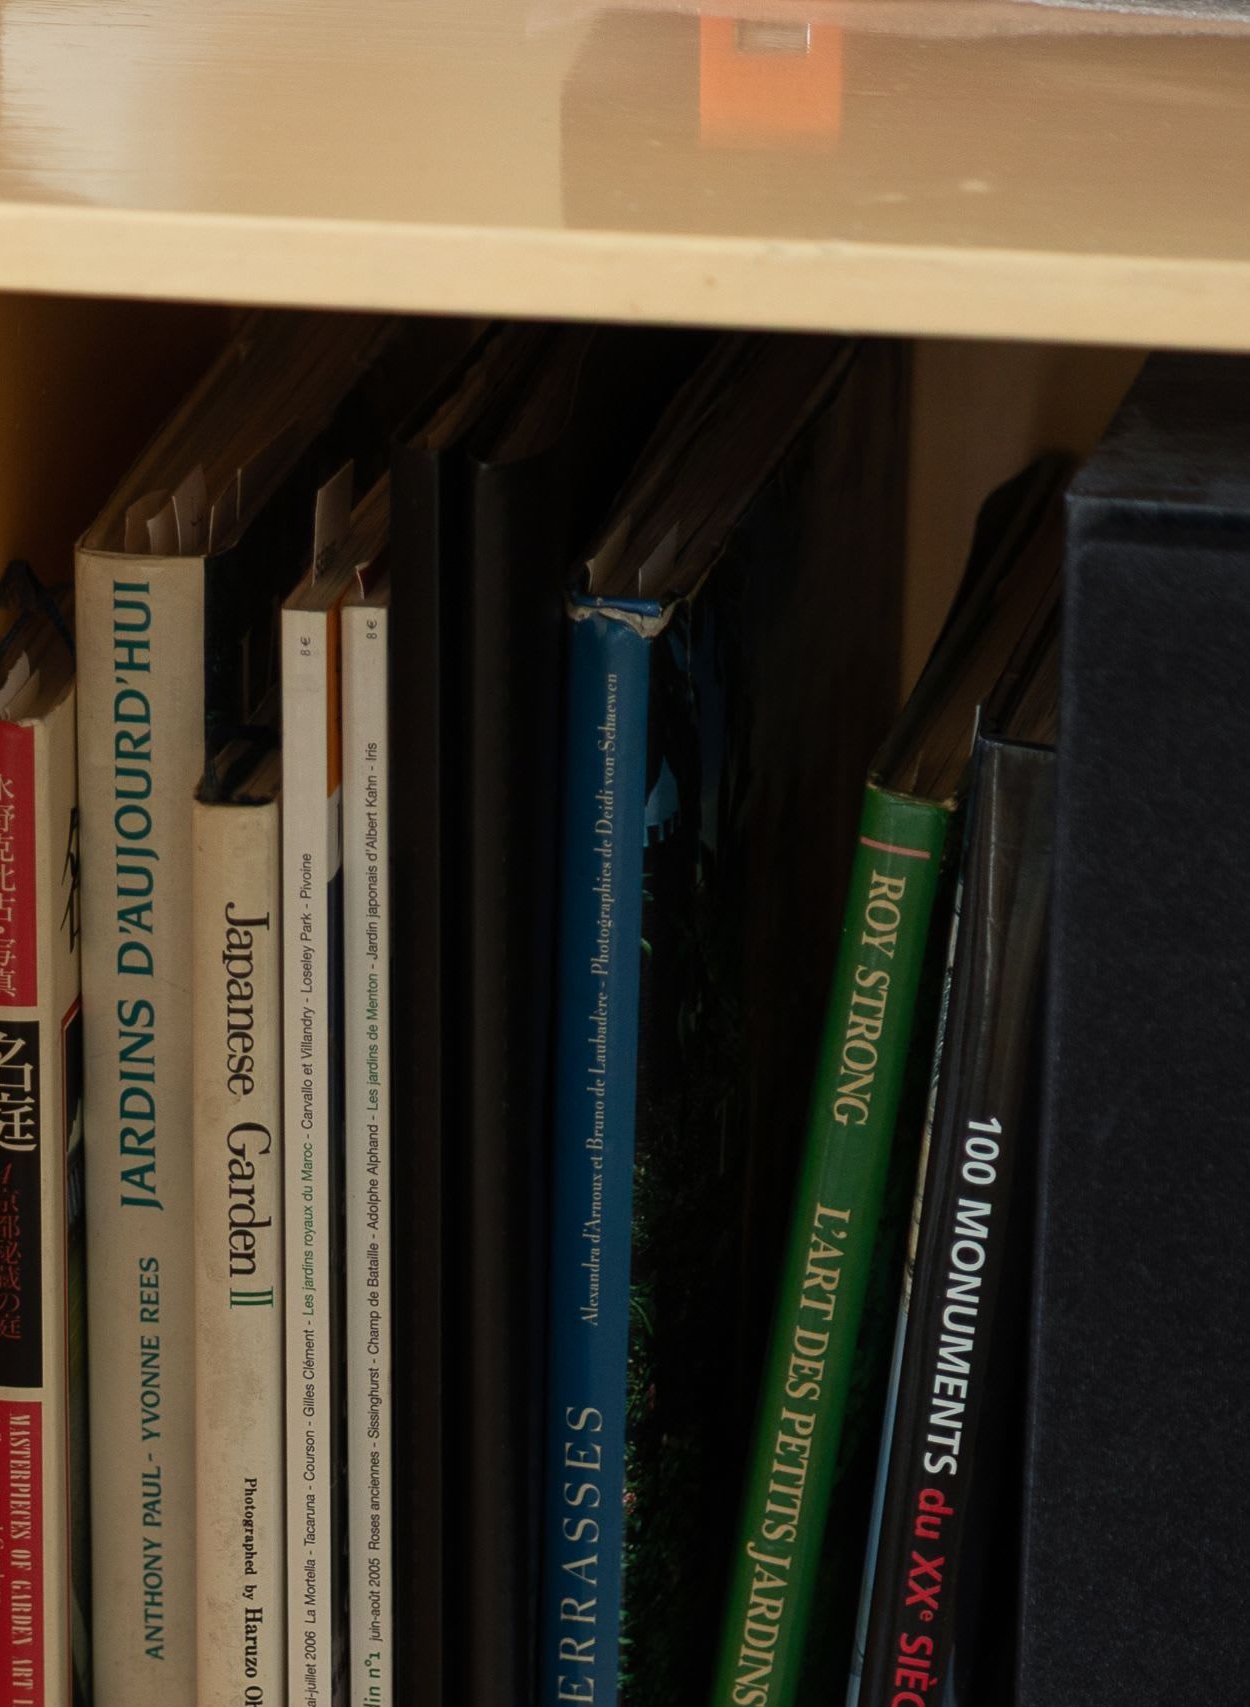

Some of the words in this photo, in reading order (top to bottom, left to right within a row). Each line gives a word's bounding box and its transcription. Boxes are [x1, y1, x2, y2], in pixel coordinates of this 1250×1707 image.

[597, 673, 618, 751] Schaewen
[365, 742, 378, 761] Iris
[365, 775, 378, 808] Kahn
[593, 789, 615, 834] Deidi
[593, 840, 613, 857] de
[299, 853, 312, 899] Pivoine
[365, 865, 381, 918] japonais
[299, 914, 312, 942] Park
[590, 863, 615, 977] Photographies
[861, 870, 906, 959] ROY
[365, 921, 378, 961] Jardin
[300, 945, 316, 994] Loseley
[223, 902, 270, 1096] Japanese
[365, 973, 378, 1022] Menton
[300, 1008, 316, 1060] Villandry
[365, 1025, 379, 1041] de
[588, 993, 608, 1075] Laubadère
[831, 964, 890, 1126] STRONG
[365, 1044, 381, 1086] jardins
[586, 1080, 607, 1097] de
[117, 999, 164, 1212] JARDINS
[300, 1080, 314, 1131] Carvallo
[366, 1089, 379, 1111] Les
[366, 1124, 382, 1176] Alphand
[585, 1102, 606, 1152] Bruno
[962, 1116, 1003, 1185] 100
[300, 1143, 314, 1182] Maroc
[226, 1121, 272, 1277] Garden
[301, 1186, 314, 1203] du
[366, 1179, 383, 1231] Adolphe
[303, 1206, 317, 1248] royaux
[301, 1251, 316, 1293] jardins
[367, 1243, 379, 1288] Bataille
[580, 1248, 601, 1327] Alexandra
[139, 1258, 159, 1325] REES
[302, 1295, 315, 1316] Les
[302, 1329, 315, 1380] Clément
[367, 1311, 383, 1355] Champ
[923, 1197, 992, 1476] MONUMENTS
[781, 1325, 830, 1400] DES
[140, 1337, 161, 1443] YVONNE
[302, 1383, 316, 1417] Gilles
[367, 1368, 383, 1440] Sissinghurst
[10, 1413, 32, 1540] MASTERPIECES
[303, 1430, 316, 1481] Courson
[368, 1451, 381, 1511] anciennes
[761, 1406, 816, 1543] PETITS
[141, 1467, 162, 1529] PAUL
[303, 1494, 316, 1547] Tacaruna
[914, 1488, 954, 1540] du
[242, 1477, 258, 1575] Photographed
[368, 1514, 381, 1550] Roses
[10, 1549, 33, 1571] OF
[303, 1559, 316, 1605] Mortella
[368, 1558, 381, 1588] 2005
[11, 1580, 33, 1646] GARDEN
[141, 1537, 165, 1660] ANTHONY
[242, 1584, 257, 1600] by
[367, 1591, 383, 1642] juin-août
[244, 1606, 263, 1678] Haruzo
[304, 1631, 316, 1659] 2006
[731, 1540, 792, 1707] JARDINS
[12, 1656, 34, 1690] ART
[365, 1652, 382, 1679] n°1
